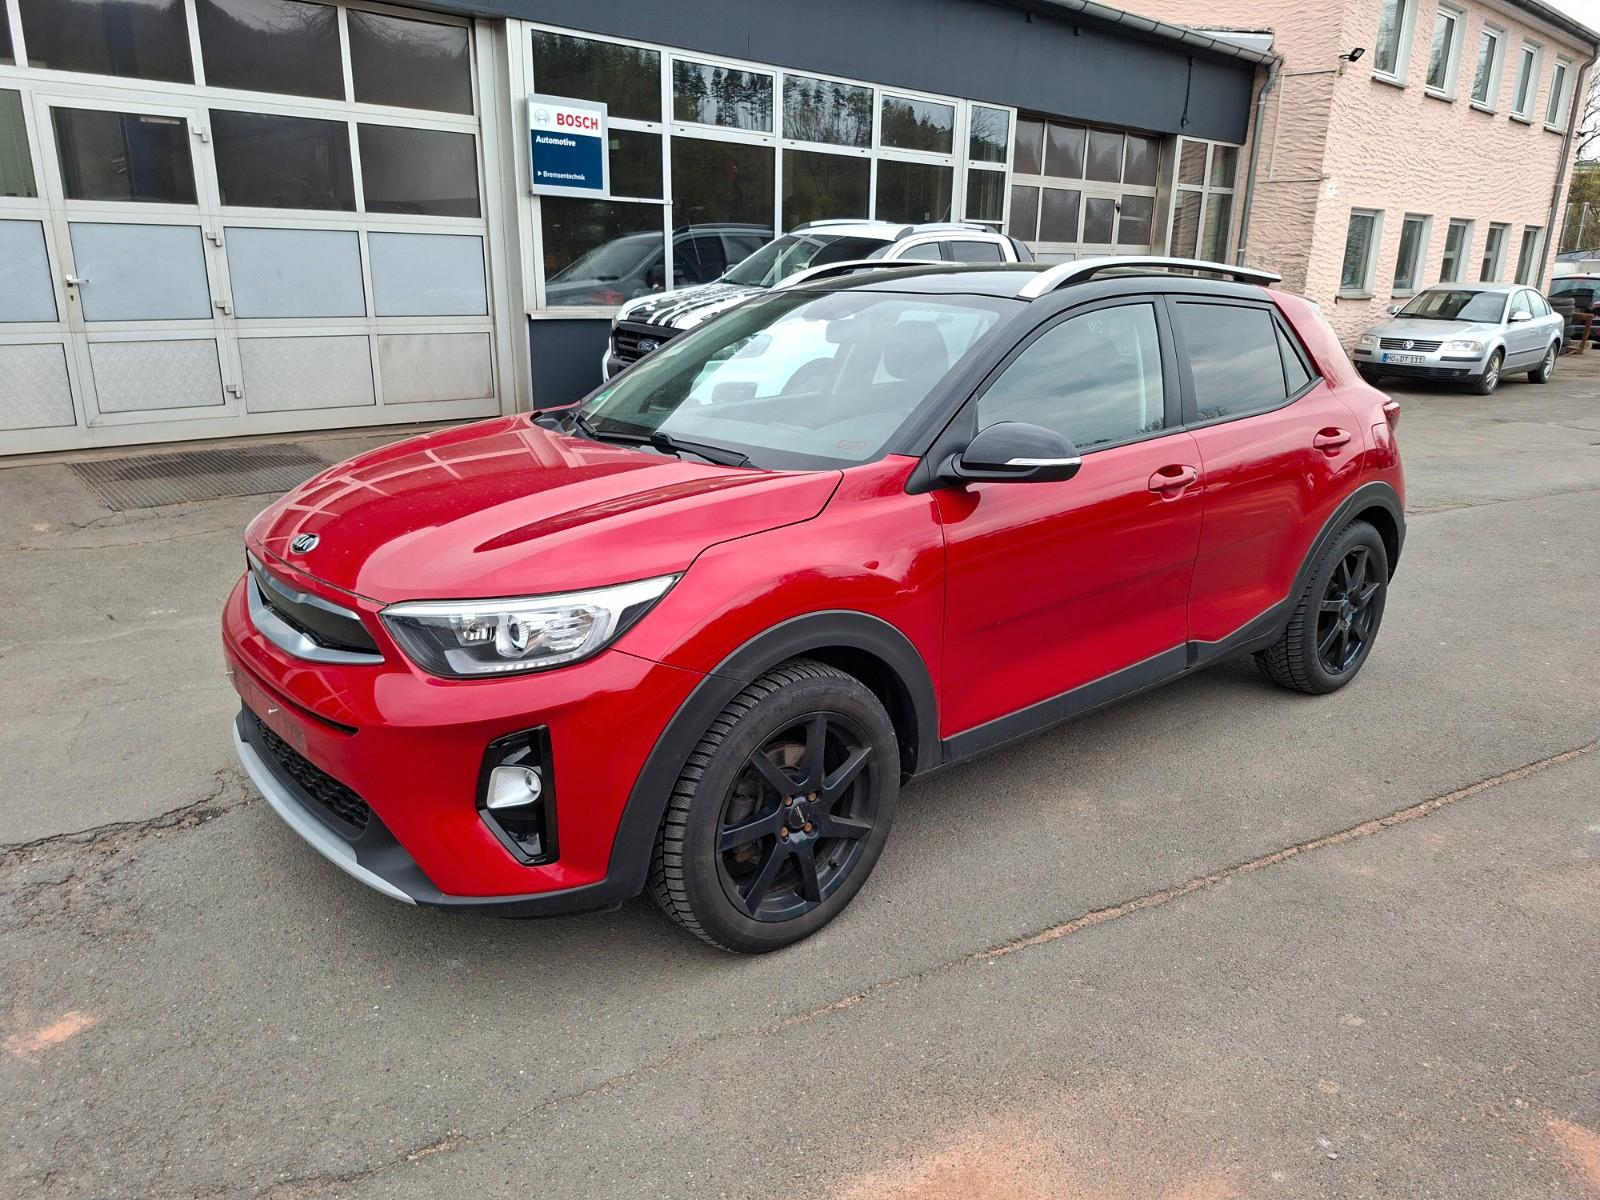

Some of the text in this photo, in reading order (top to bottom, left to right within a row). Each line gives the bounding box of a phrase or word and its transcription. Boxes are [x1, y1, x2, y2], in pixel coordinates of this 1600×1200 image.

[556, 112, 598, 130] BOSCH
[535, 135, 577, 147] Automotive
[542, 170, 586, 181] Bremsentechnik
